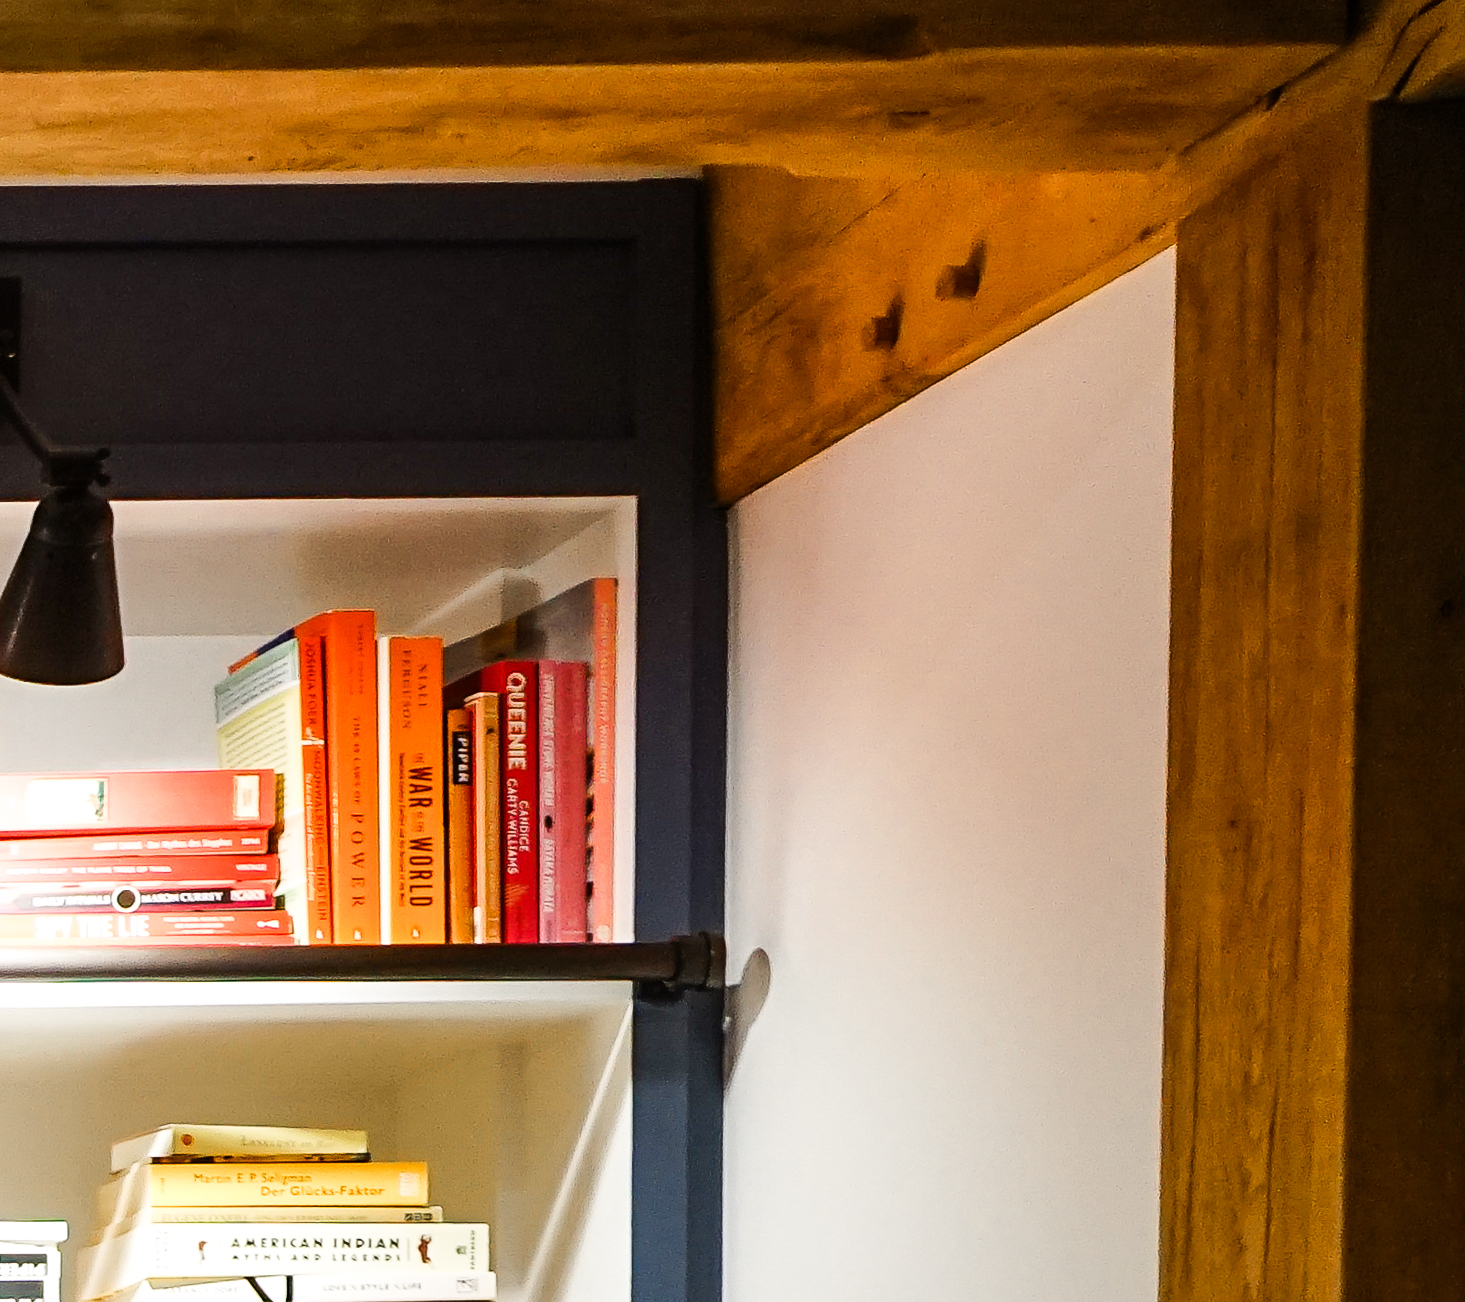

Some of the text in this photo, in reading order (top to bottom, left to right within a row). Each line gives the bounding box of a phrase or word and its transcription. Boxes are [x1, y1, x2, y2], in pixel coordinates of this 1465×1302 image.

[507, 673, 526, 770] QUEENIE
[408, 767, 433, 907] WAR WORLD
[261, 1186, 385, 1197] Der Glücks-Faktor
[231, 1238, 399, 1248] AMERICAN INDIAN
